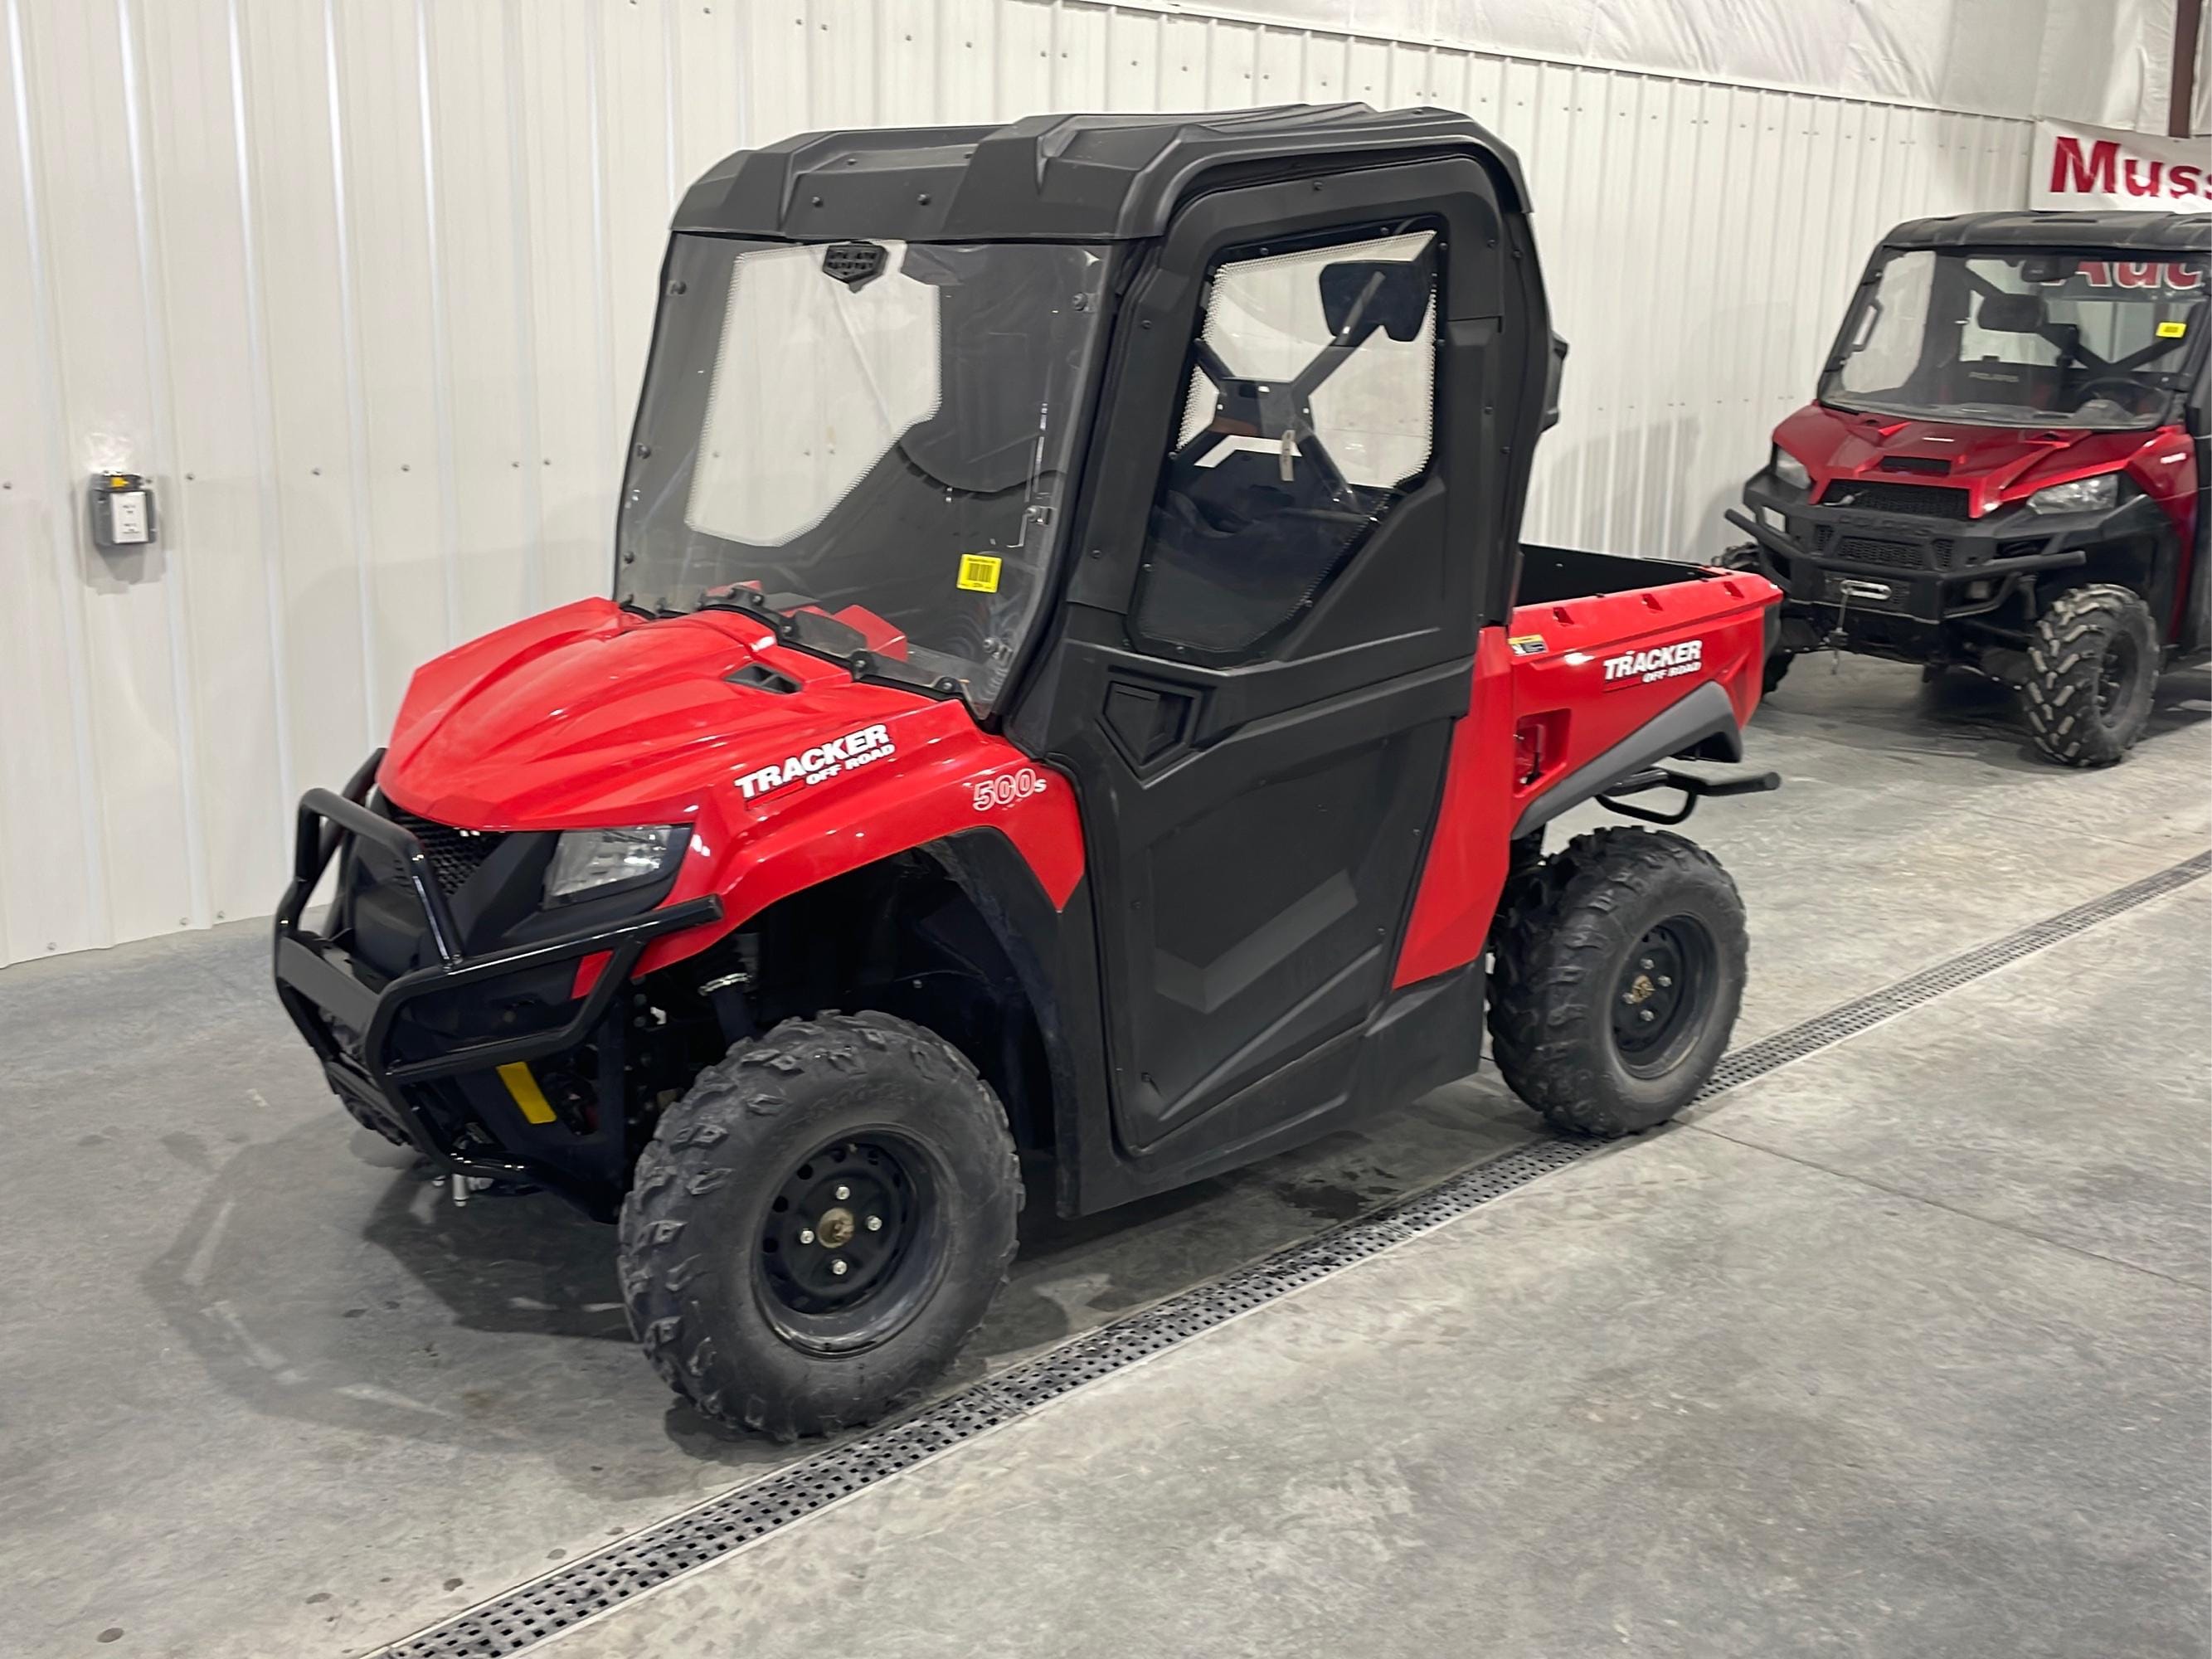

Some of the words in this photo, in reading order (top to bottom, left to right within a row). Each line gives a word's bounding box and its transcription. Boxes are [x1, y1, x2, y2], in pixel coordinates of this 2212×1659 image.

[2049, 135, 2212, 200] Mus
[1603, 640, 1703, 680] TRACKER
[1642, 669, 1668, 684] OFF
[734, 723, 890, 798] TRACKER
[805, 764, 843, 785] OFF
[844, 744, 896, 770] ROAD
